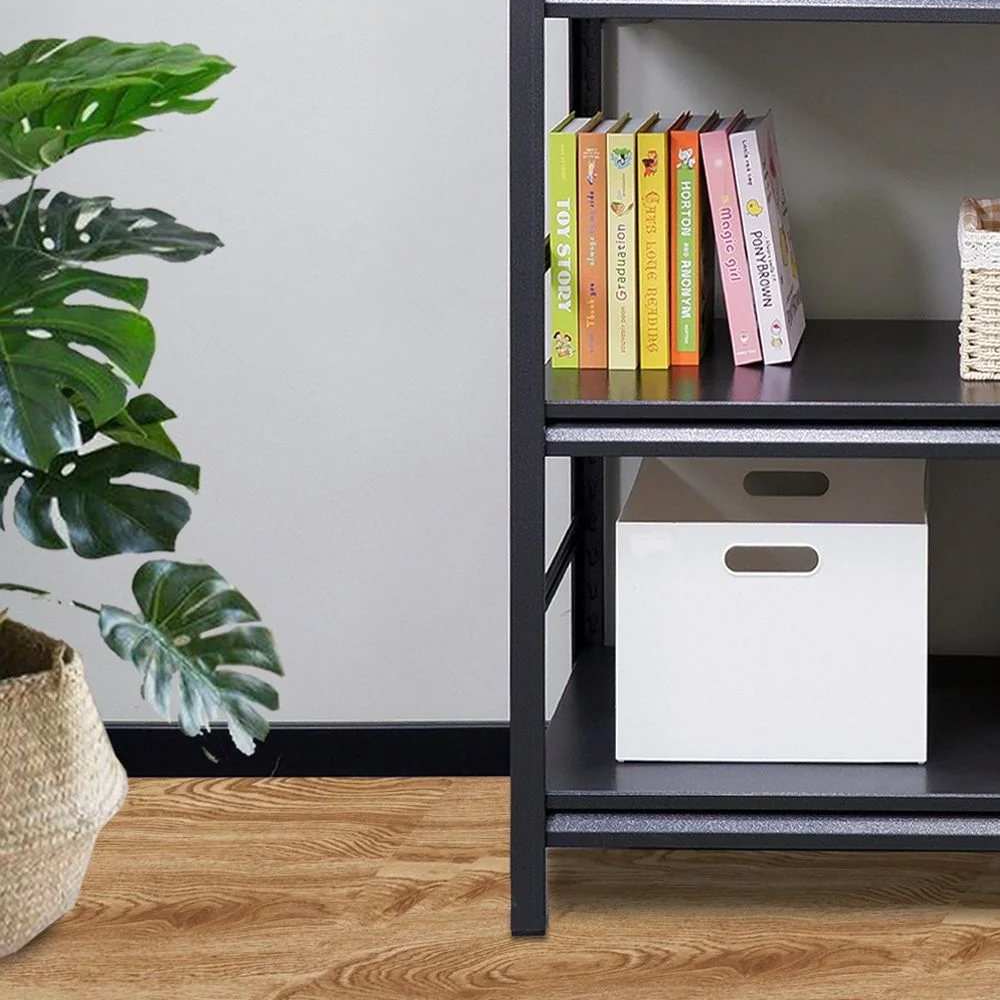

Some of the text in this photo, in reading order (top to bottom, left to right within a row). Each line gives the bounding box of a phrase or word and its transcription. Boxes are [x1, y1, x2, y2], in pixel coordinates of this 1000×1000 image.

[556, 198, 571, 239] TOY
[681, 181, 692, 236] HORTON
[557, 242, 572, 313] STORY
[615, 224, 628, 301] Graduation
[725, 256, 742, 284] girl
[750, 230, 773, 308] PONYBROWN
